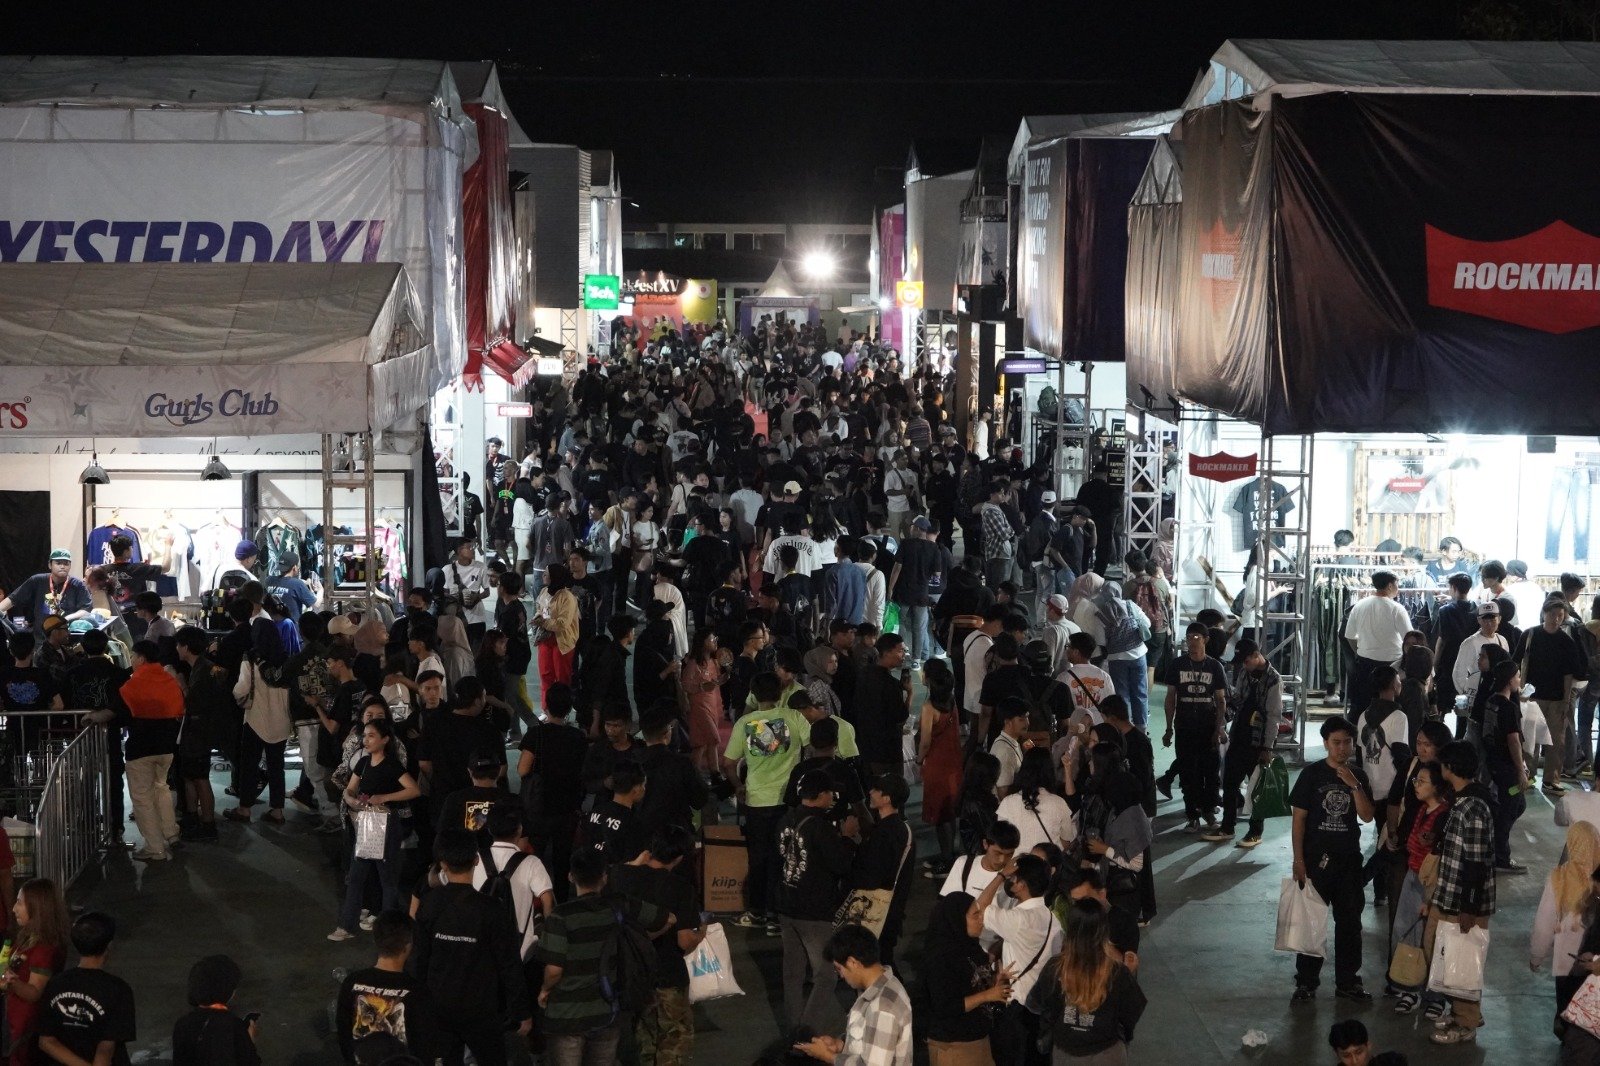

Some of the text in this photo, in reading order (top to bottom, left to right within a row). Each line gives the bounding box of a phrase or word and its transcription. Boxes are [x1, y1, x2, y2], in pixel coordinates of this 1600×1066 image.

[1453, 261, 1600, 291] ROCKMA
[219, 388, 279, 417] Club
[1197, 462, 1249, 472] ROCKMAKER
[468, 801, 489, 814] Good
[590, 812, 621, 831] WYS
[712, 876, 738, 889] kiip
